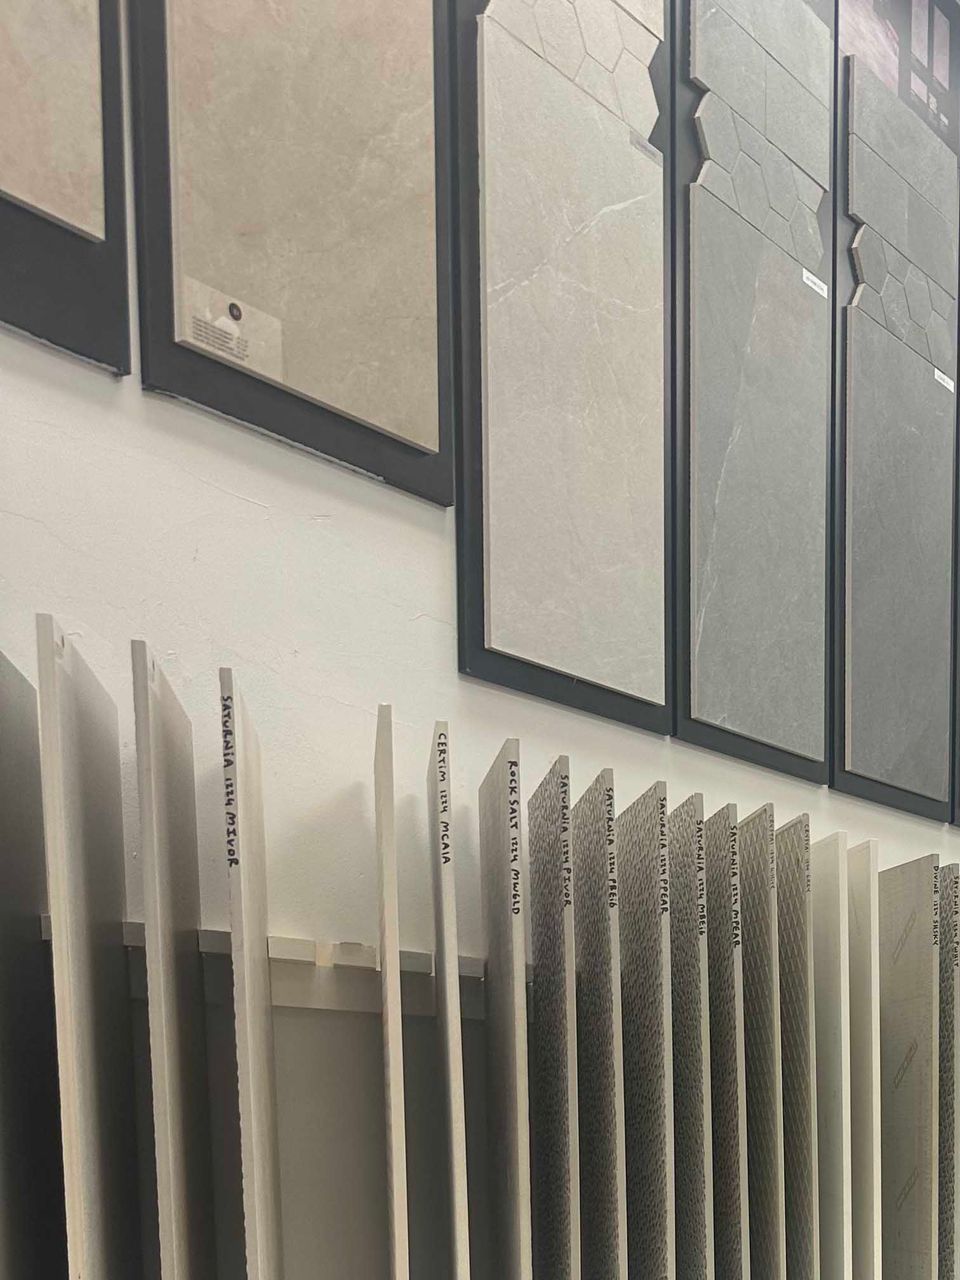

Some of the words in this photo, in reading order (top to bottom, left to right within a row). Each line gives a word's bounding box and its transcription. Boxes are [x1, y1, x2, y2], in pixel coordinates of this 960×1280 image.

[508, 760, 518, 796] ROCK
[509, 800, 519, 830] SALT
[226, 811, 239, 868] MIVOR
[660, 878, 668, 915] PPEAR
[732, 909, 740, 949] MPEAR
